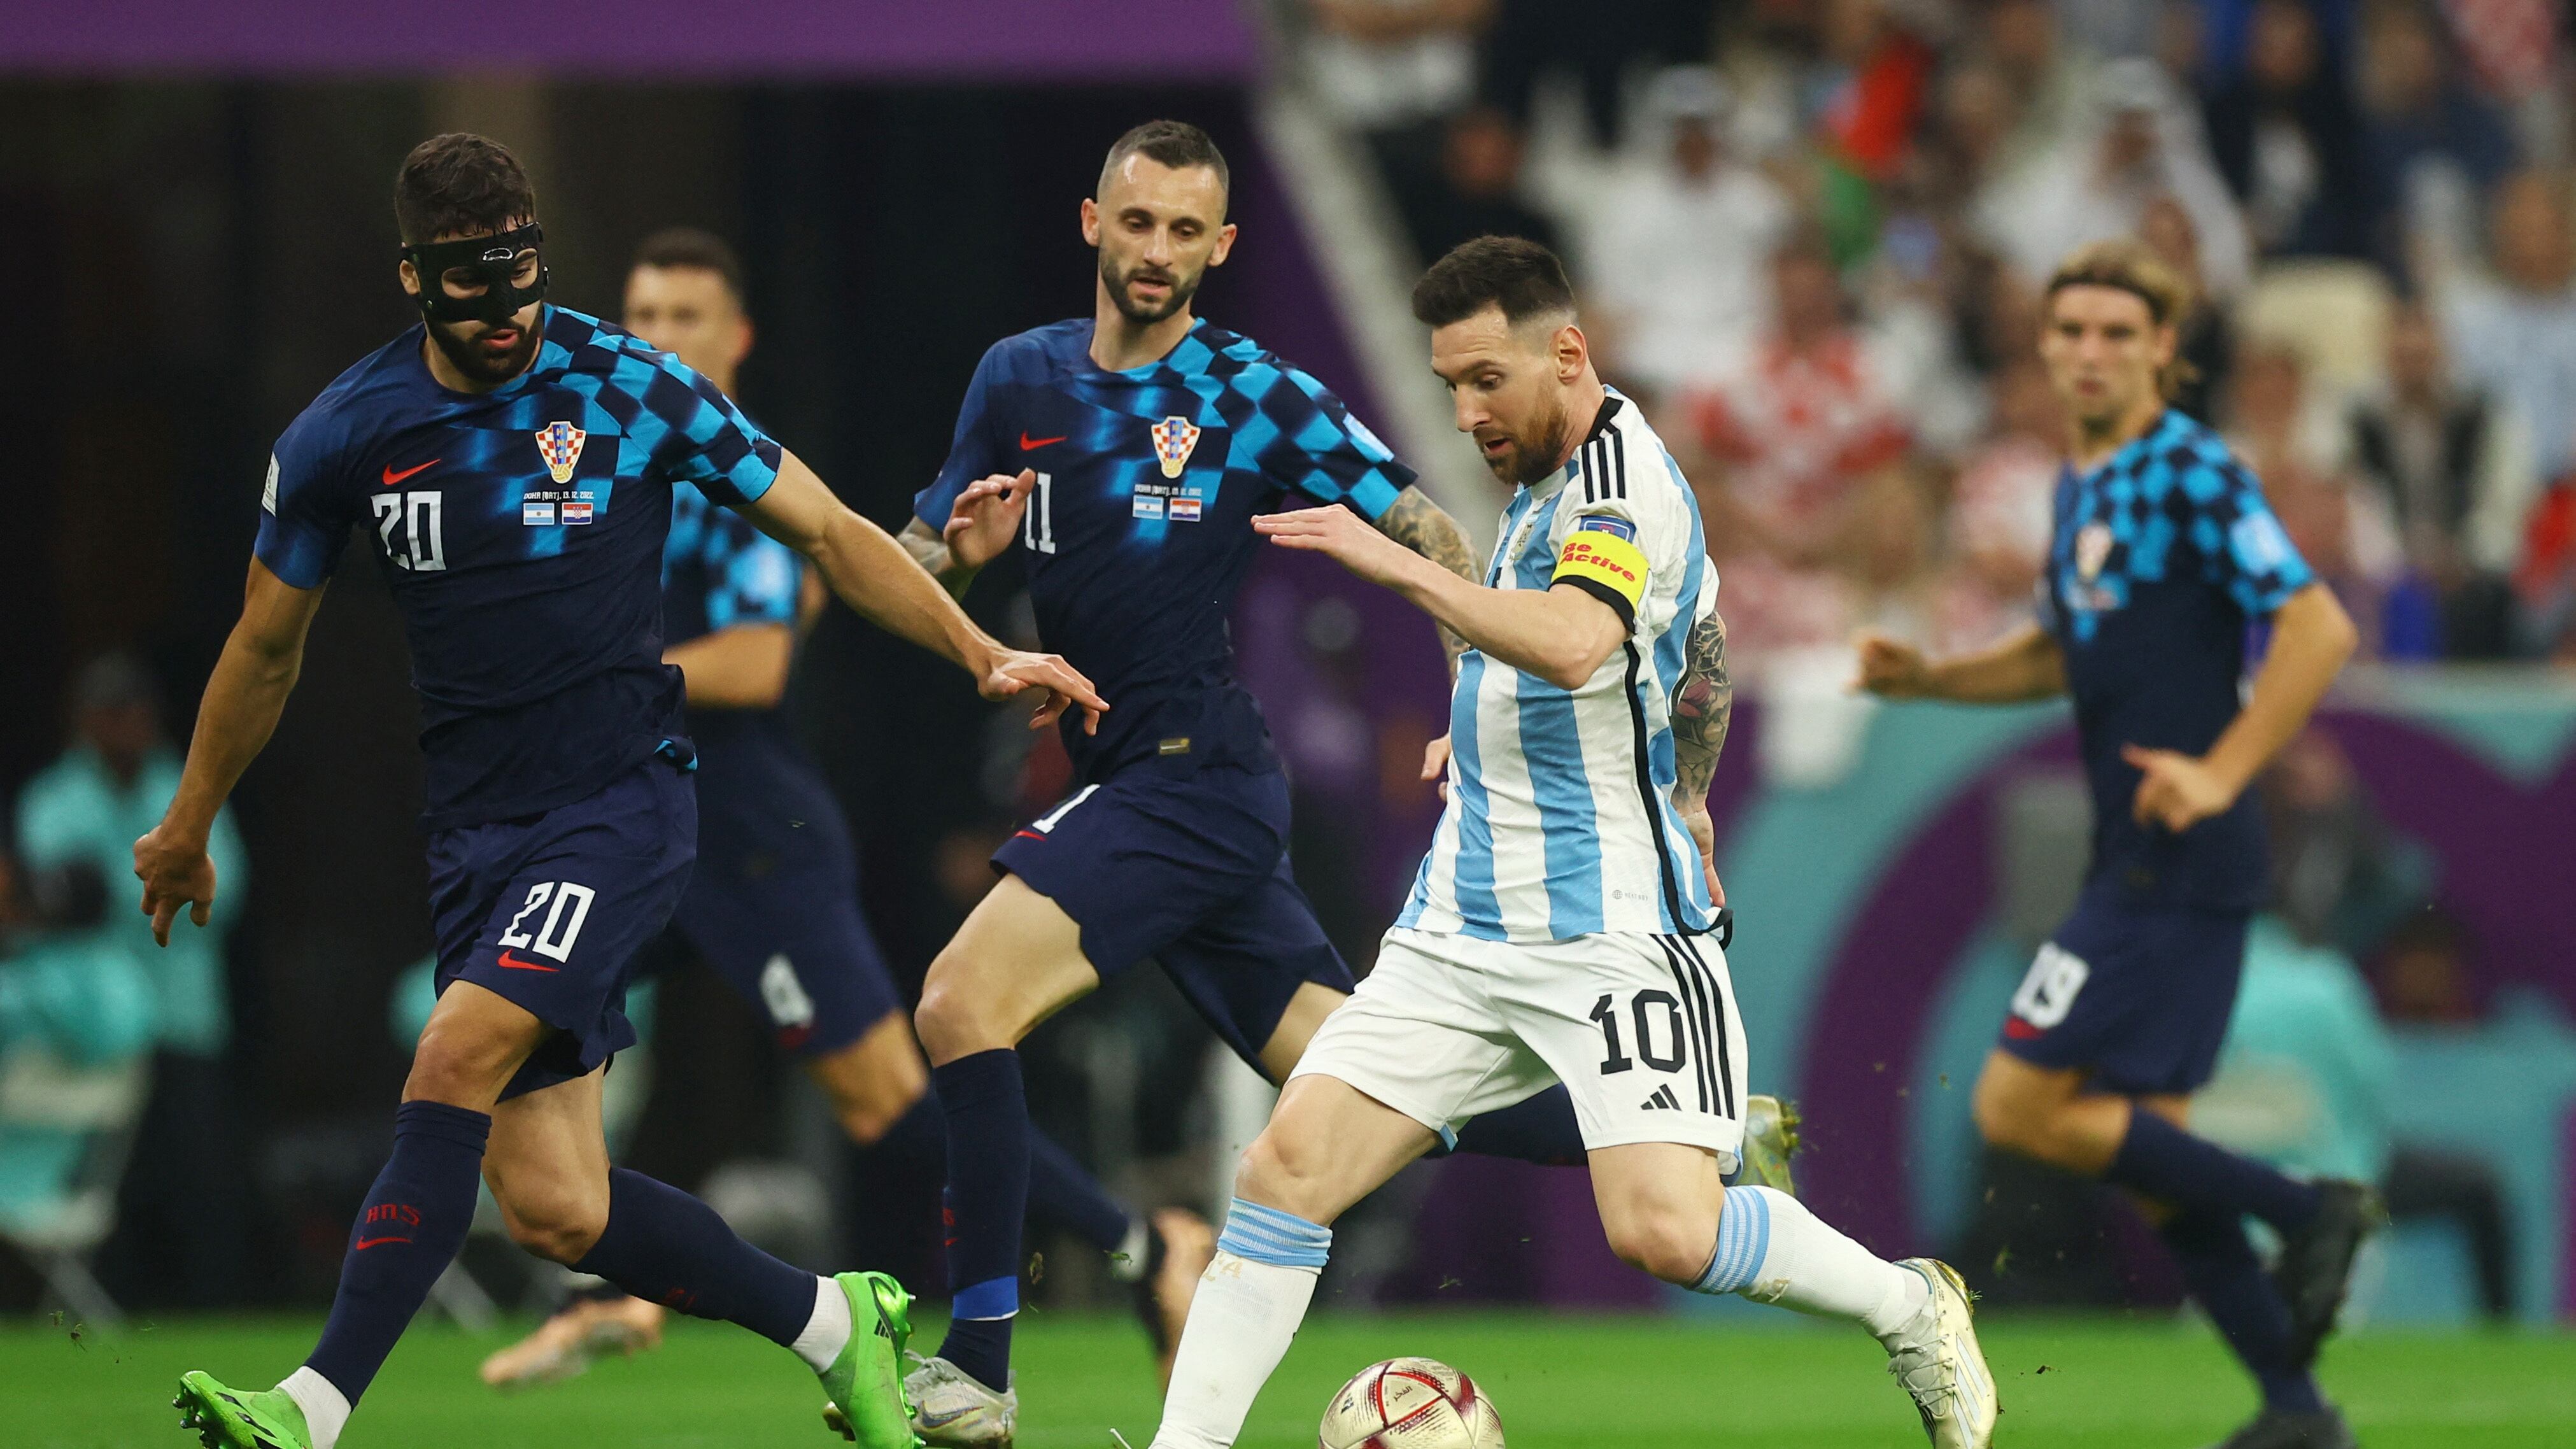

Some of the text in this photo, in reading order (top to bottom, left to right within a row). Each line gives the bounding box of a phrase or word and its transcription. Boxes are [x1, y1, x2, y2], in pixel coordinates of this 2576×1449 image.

[370, 491, 446, 571] 20
[1559, 553, 1636, 582] Active
[1562, 542, 1592, 556] Be
[497, 881, 596, 964] 20
[2011, 940, 2090, 1029] 19
[1589, 989, 1686, 1076] 10
